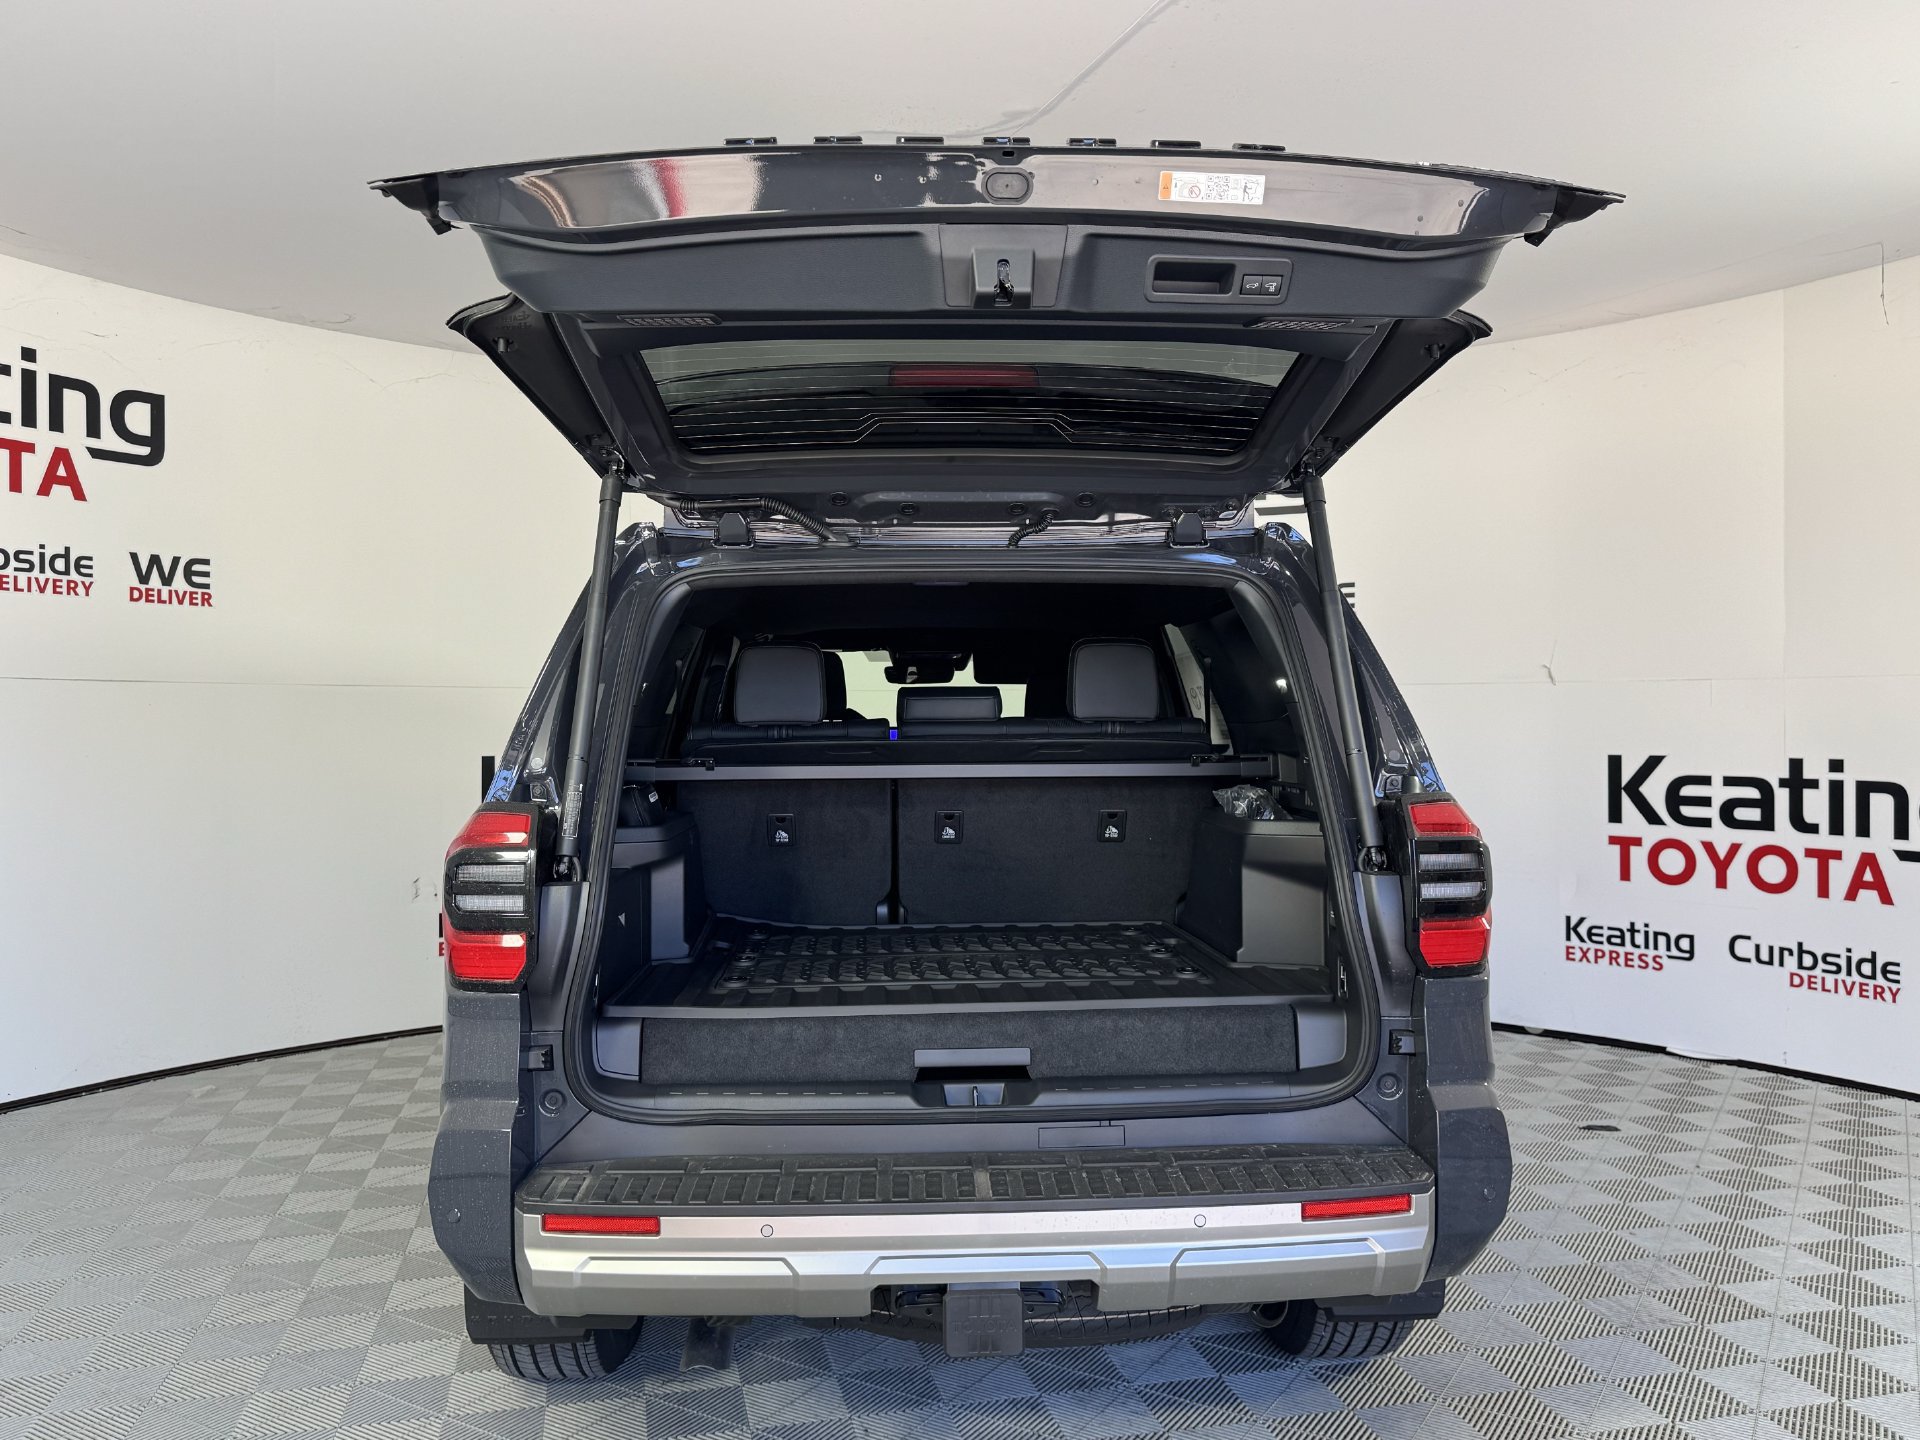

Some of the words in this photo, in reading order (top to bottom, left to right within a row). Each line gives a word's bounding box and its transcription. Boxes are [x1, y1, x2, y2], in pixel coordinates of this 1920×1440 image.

[129, 552, 211, 590] WE
[129, 586, 212, 607] DELIVER
[1608, 755, 1920, 863] Keatin
[1608, 835, 1894, 906] TOYOTA
[1565, 915, 1695, 961] Keating
[1565, 945, 1664, 972] EXPRESS
[1729, 935, 1900, 984] Curbside
[1789, 972, 1900, 1004] DELIVERY
